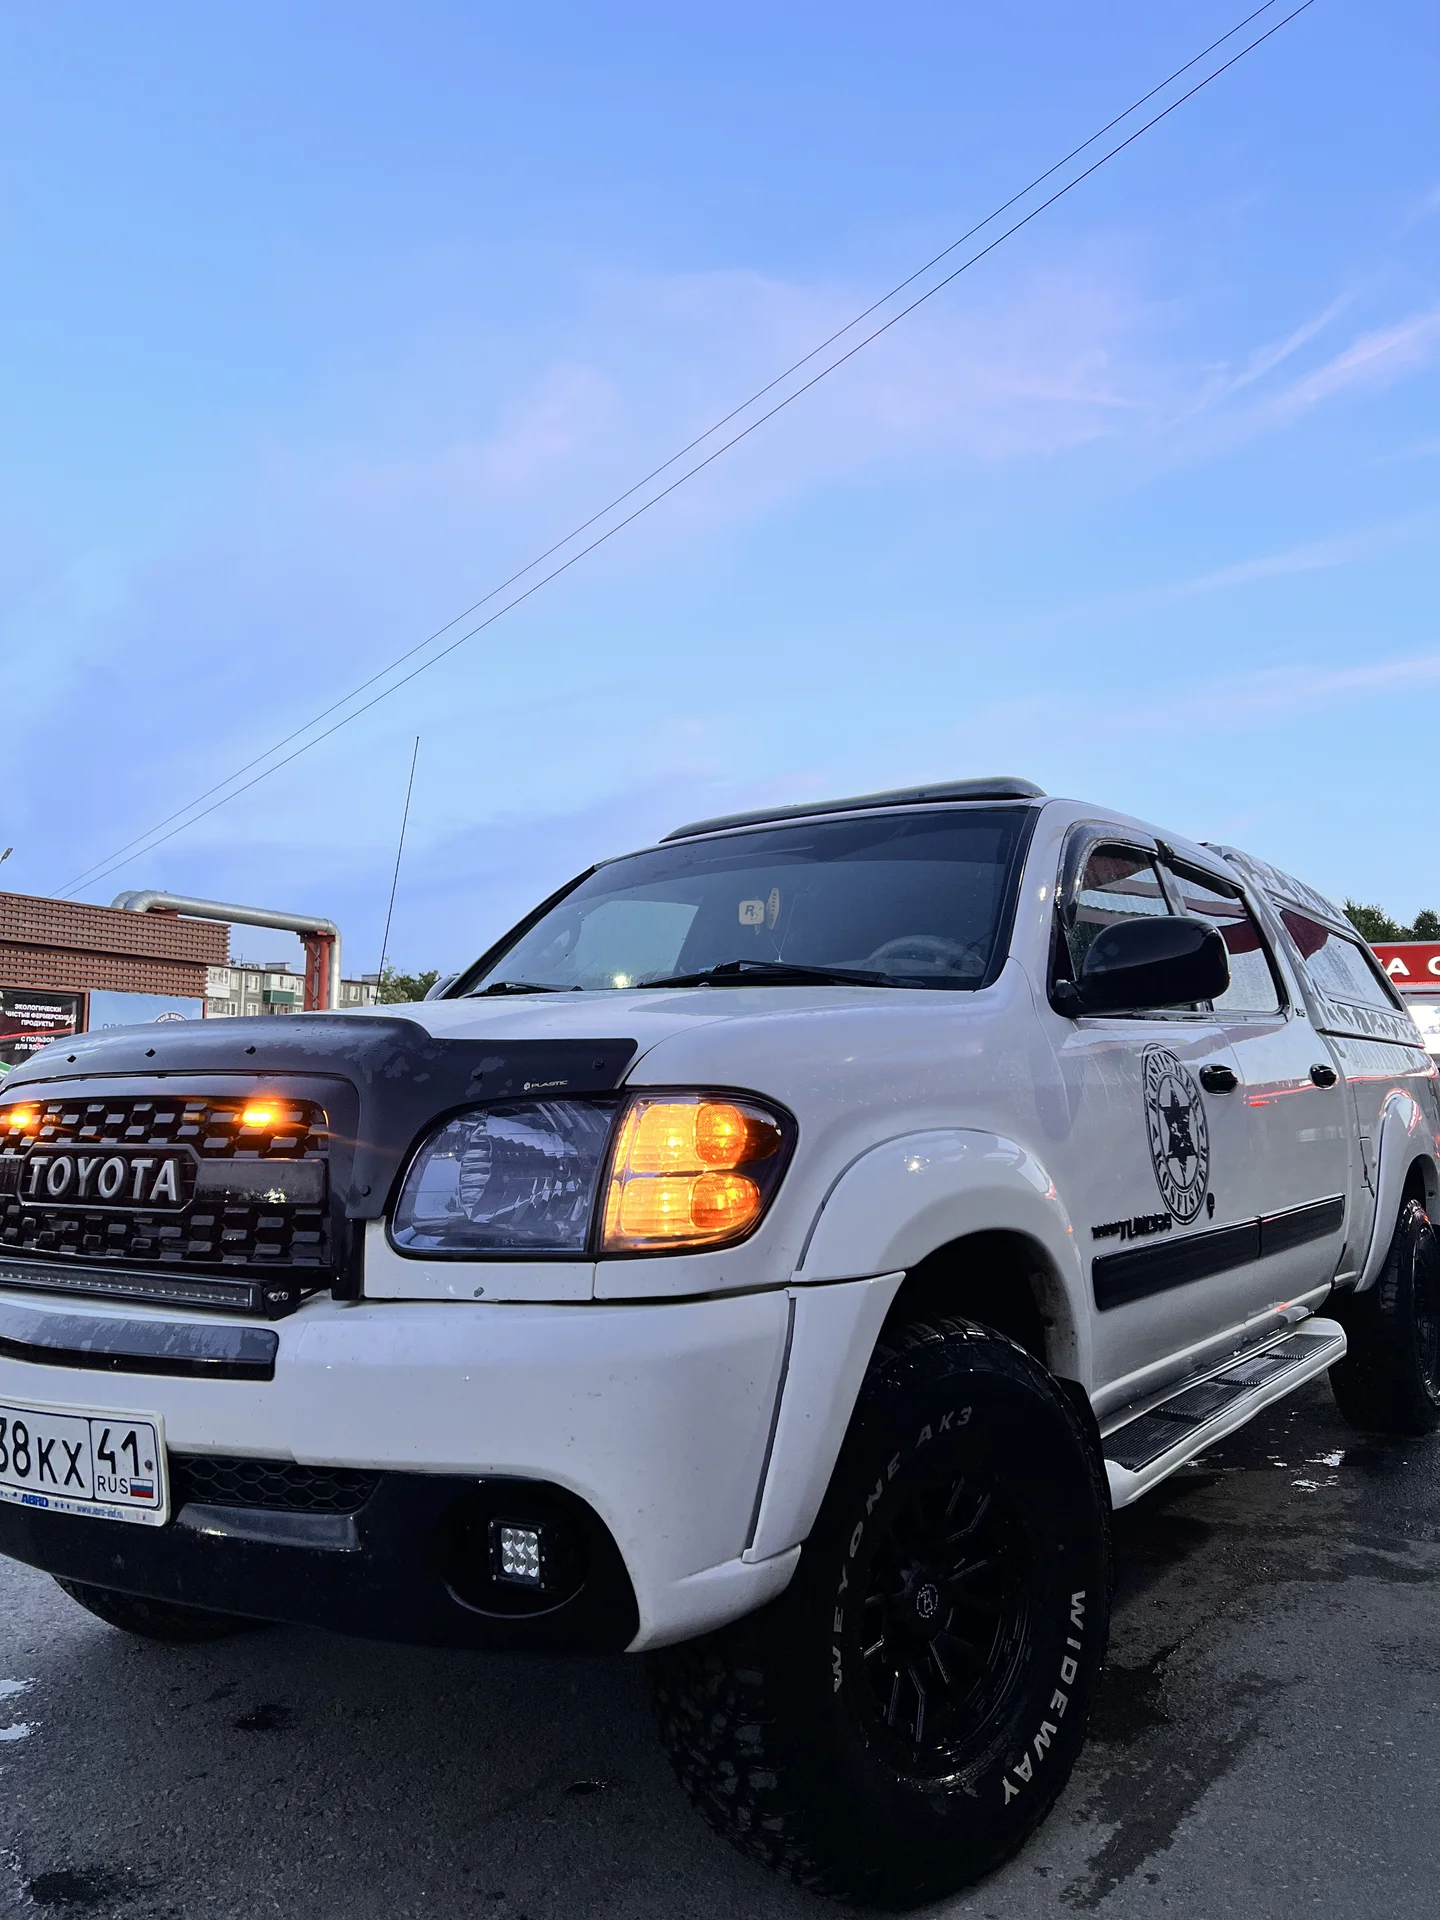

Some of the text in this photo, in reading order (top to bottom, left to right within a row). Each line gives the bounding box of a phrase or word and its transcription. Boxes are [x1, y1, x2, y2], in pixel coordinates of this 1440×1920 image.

[5, 1010, 30, 1019] ЧИСТЫЕ
[31, 1013, 69, 1021] ФЕРМЕРСКИЕ
[14, 1003, 62, 1012] ЭКОЛОГИЧЕСКИ
[21, 1019, 55, 1028] ПРОДУКТЫ
[531, 1080, 569, 1088] PLASTIC
[29, 1155, 182, 1202] TOYOTA
[1119, 1211, 1172, 1240] TUNDRA
[97, 1428, 140, 1477] 41
[97, 1475, 129, 1494] RUS
[21, 1493, 49, 1508] ABRO
[832, 1406, 973, 1694] WEYONE AK3
[1003, 1590, 1087, 1806] WIDEWAY
